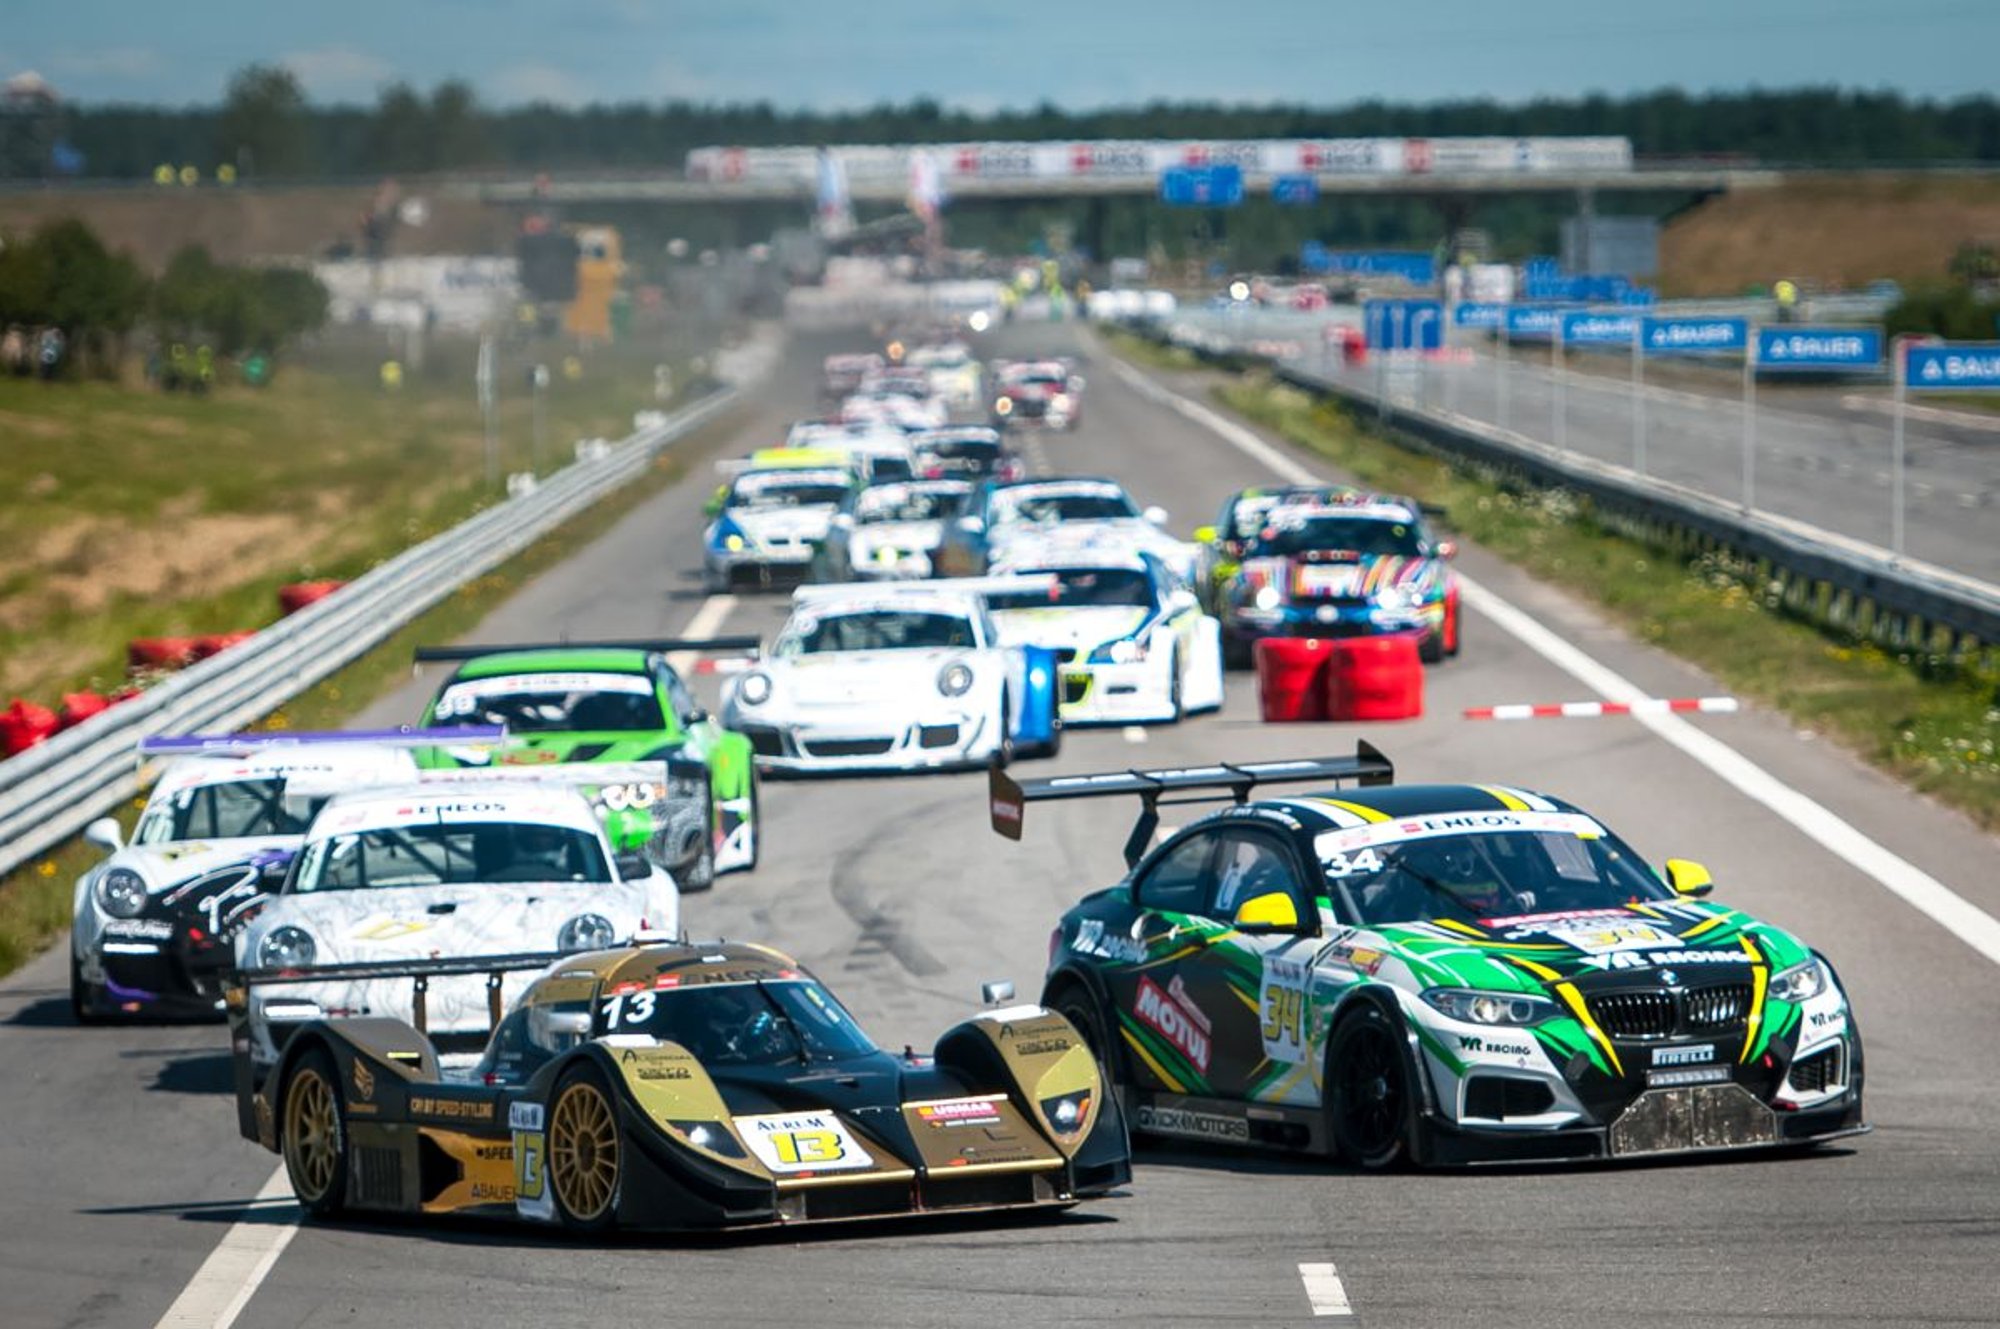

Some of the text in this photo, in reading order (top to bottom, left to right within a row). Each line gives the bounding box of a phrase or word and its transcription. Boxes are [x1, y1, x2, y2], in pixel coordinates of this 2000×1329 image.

[1789, 335, 1863, 358] BAUER
[418, 803, 506, 814] ENEOS
[1424, 815, 1521, 831] ENEOS
[1321, 848, 1383, 878] 34
[1649, 950, 1754, 966] RACING
[601, 990, 657, 1031] 13
[1263, 983, 1303, 1047] 34
[1137, 984, 1208, 1070] MOTUL
[1486, 1043, 1531, 1056] RACING
[768, 1130, 846, 1163] 13
[513, 1131, 544, 1200] 13
